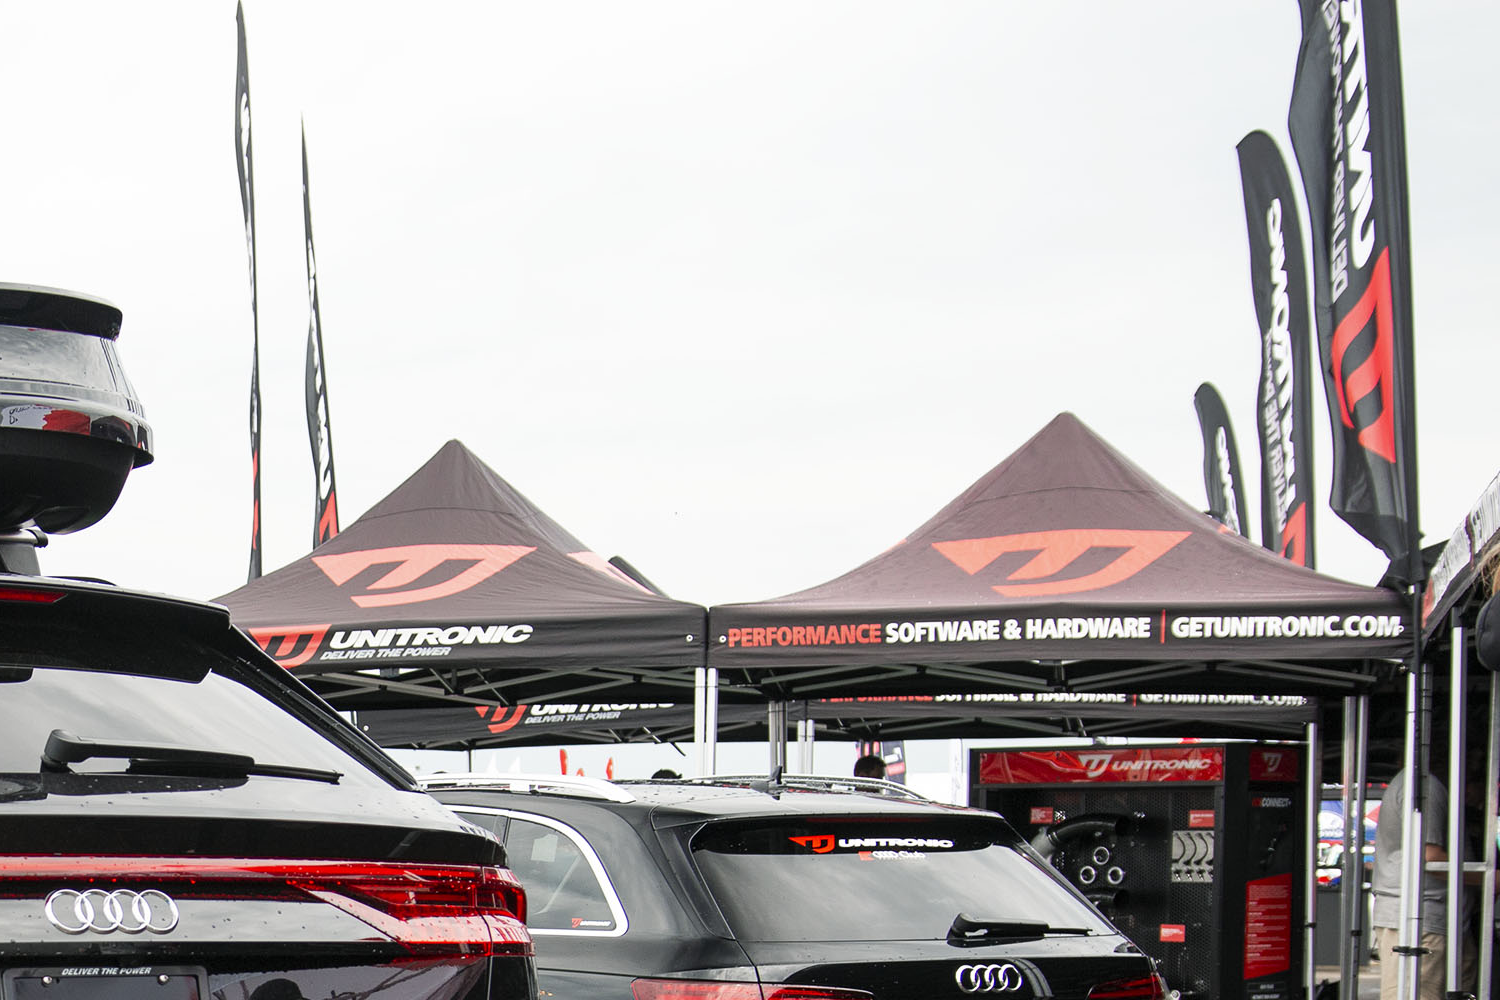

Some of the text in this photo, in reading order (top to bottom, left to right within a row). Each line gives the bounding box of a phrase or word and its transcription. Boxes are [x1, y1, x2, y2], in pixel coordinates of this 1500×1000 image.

[329, 624, 534, 649] UNITRONIC
[728, 615, 1401, 648] PERFORMANCE SOFTWARE & HARDWARE GETUNITRONIC.COM
[320, 646, 451, 660] DELIVER THE POWER
[524, 711, 621, 725] DELIVER THE POWER
[1112, 758, 1211, 771] UNITRONIC
[838, 838, 954, 849] UNITRONIC
[901, 850, 926, 860] Club
[61, 966, 152, 976] DELIVER THE POWER
